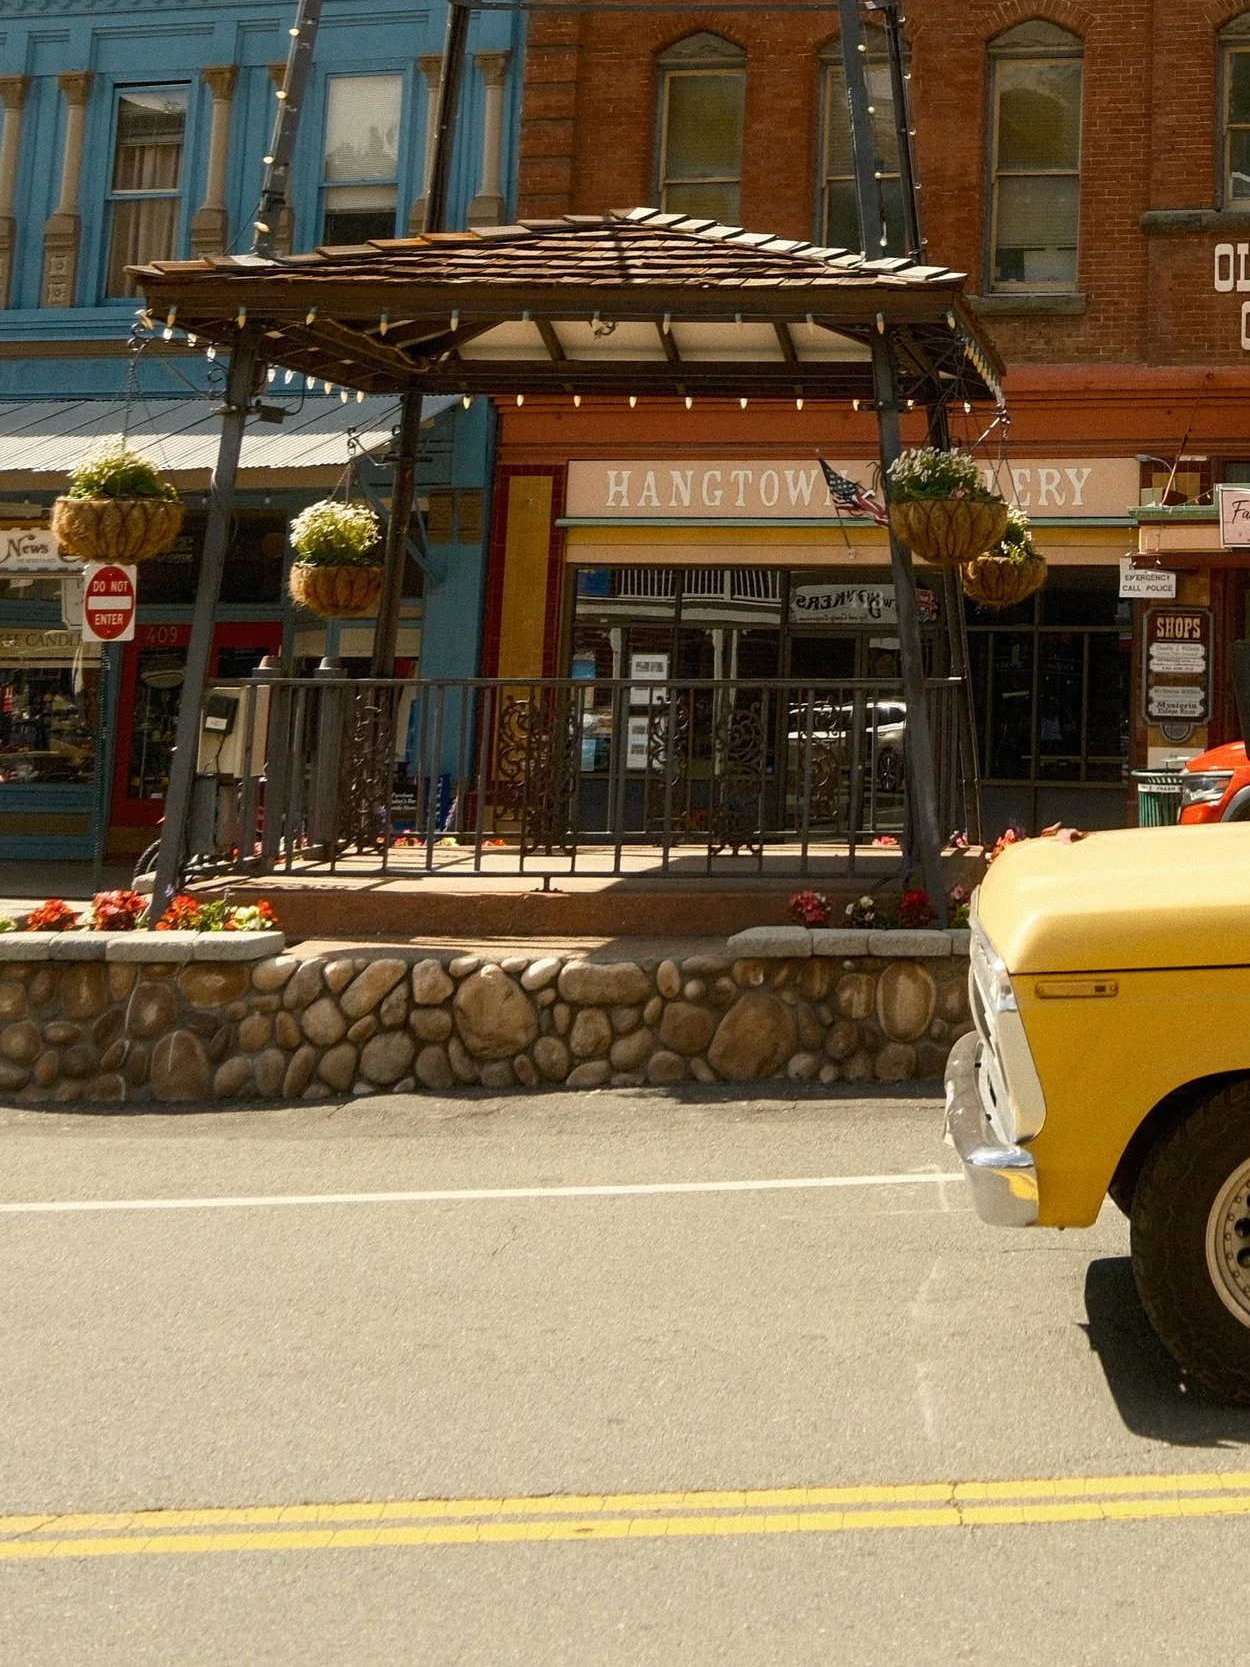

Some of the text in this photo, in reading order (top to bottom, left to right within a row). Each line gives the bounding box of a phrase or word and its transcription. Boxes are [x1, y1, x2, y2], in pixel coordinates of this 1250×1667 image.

[0, 534, 49, 563] News
[1124, 573, 1171, 582] EMERGENCY
[93, 580, 129, 592] DO NOT
[1122, 584, 1173, 592] CALL POLICE
[94, 613, 124, 625] ENTER
[1156, 617, 1201, 639] SHOPS
[146, 626, 179, 644] 409
